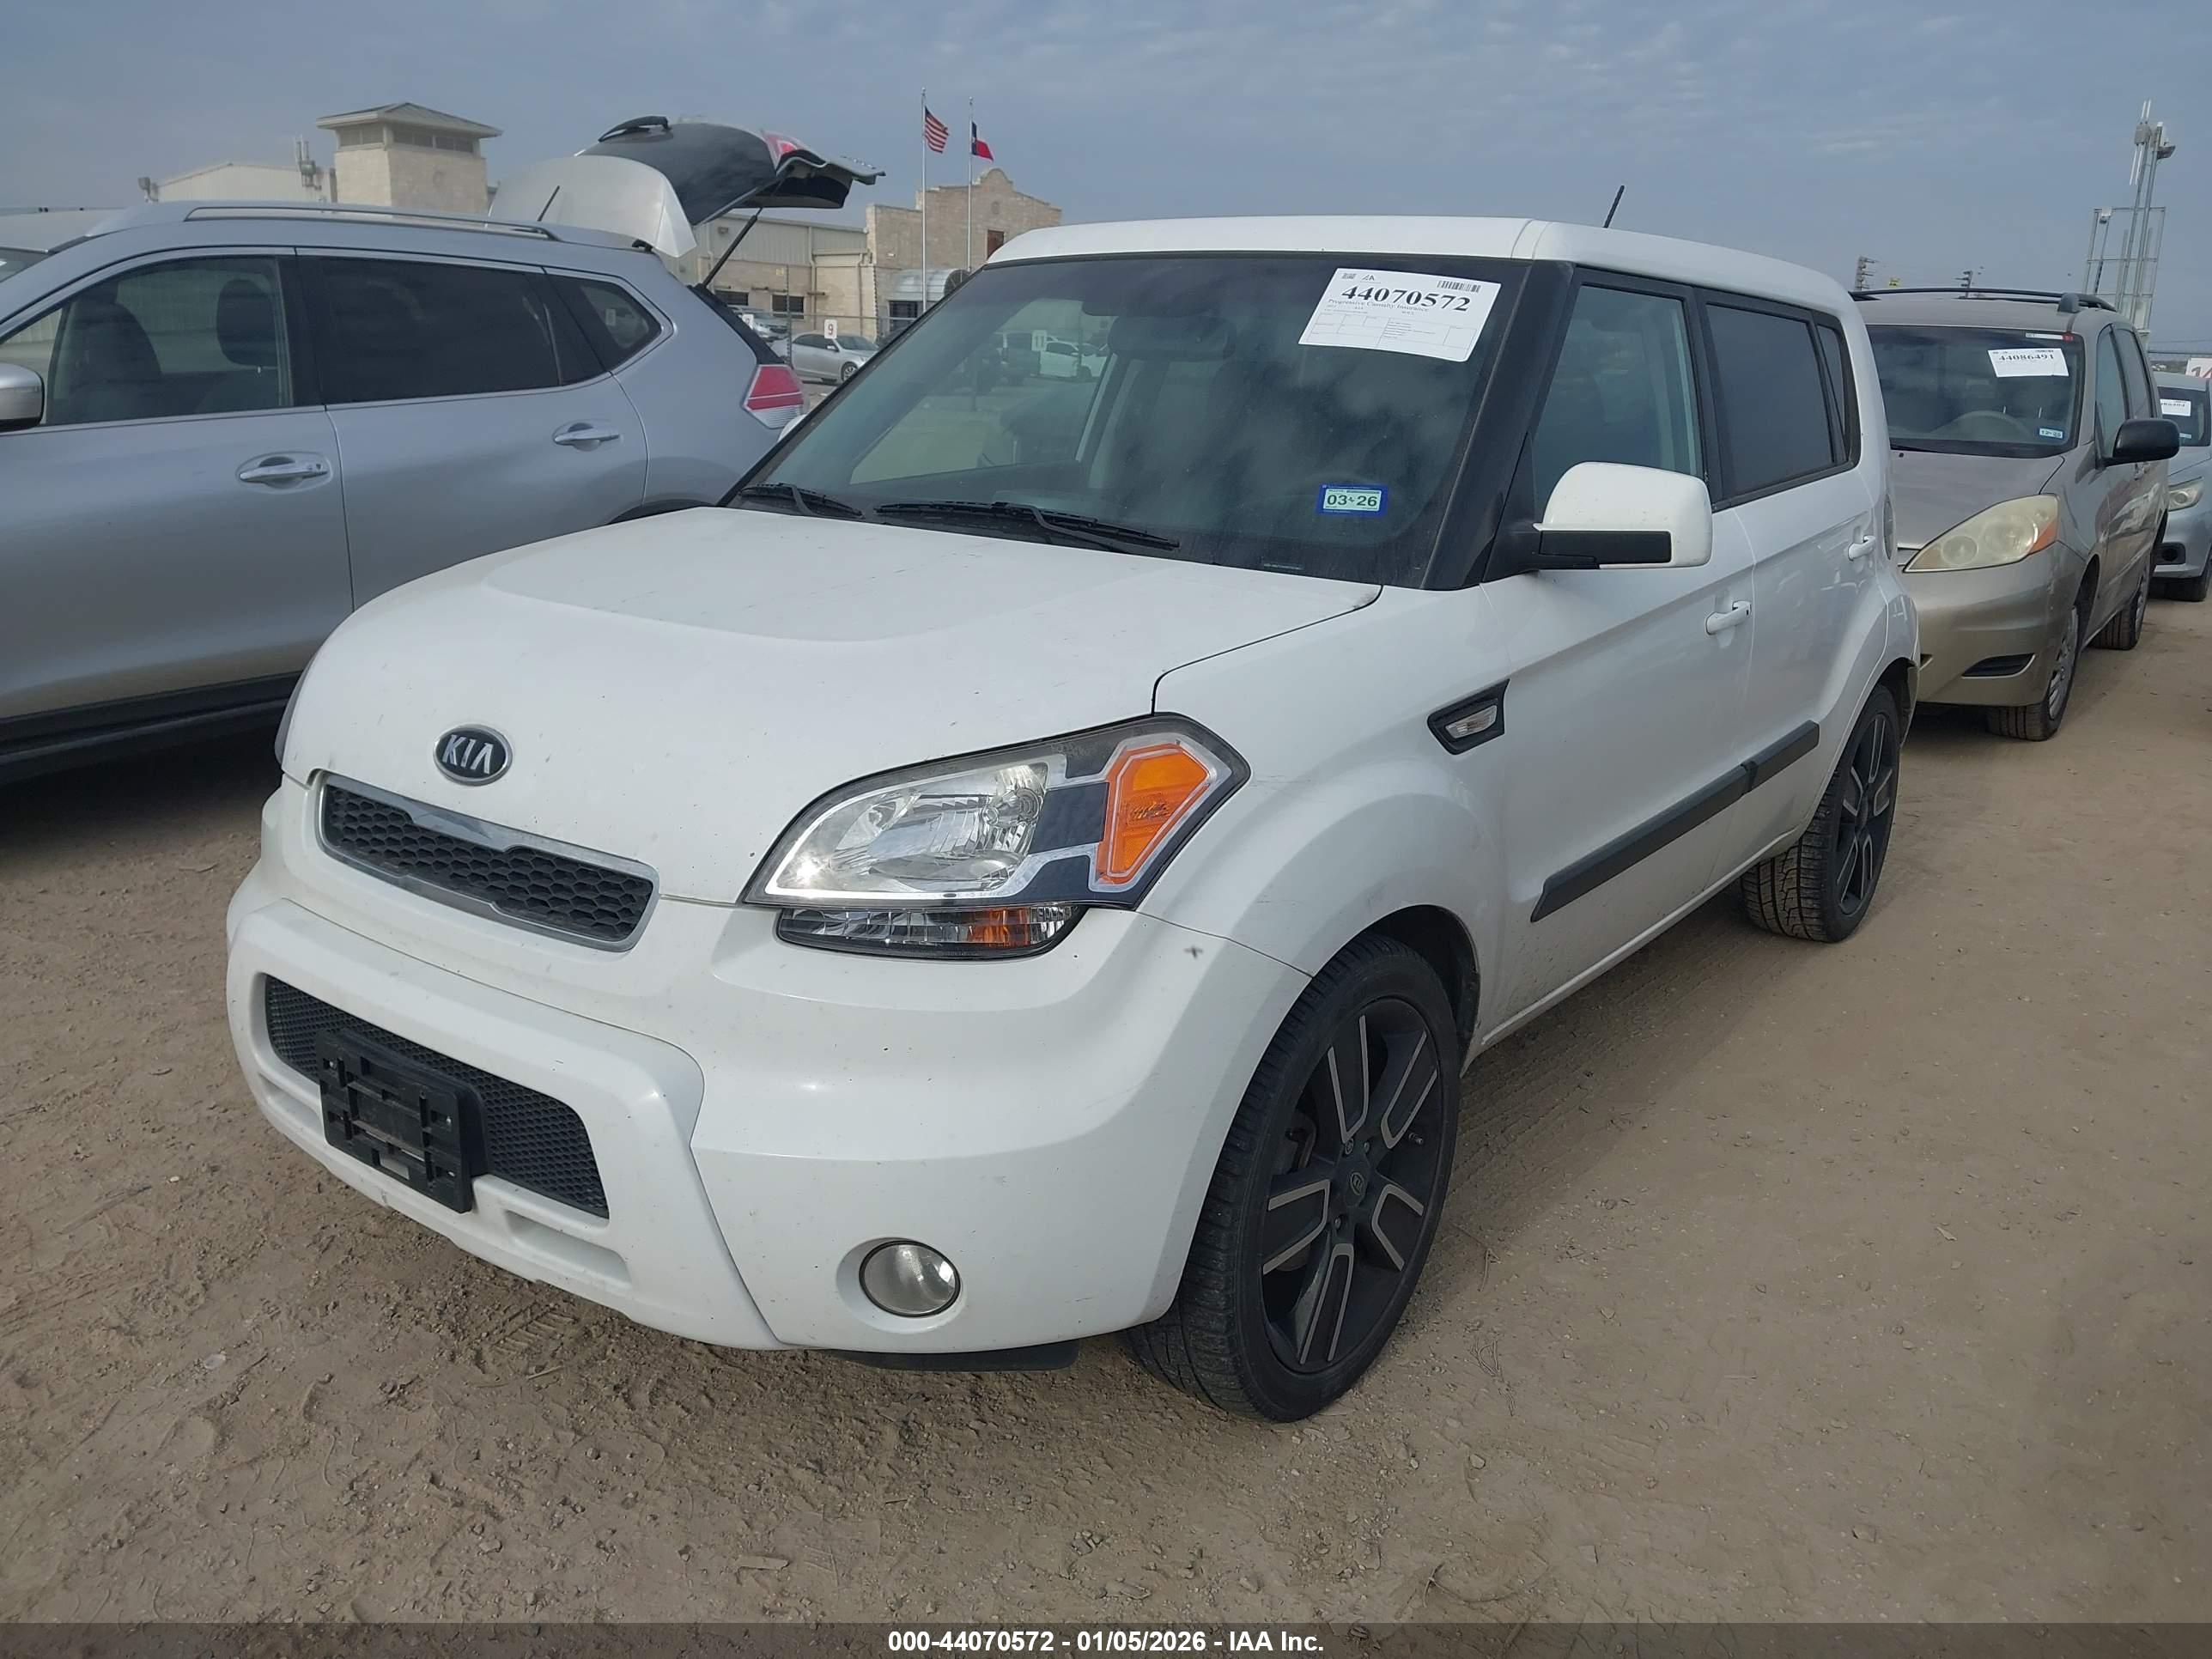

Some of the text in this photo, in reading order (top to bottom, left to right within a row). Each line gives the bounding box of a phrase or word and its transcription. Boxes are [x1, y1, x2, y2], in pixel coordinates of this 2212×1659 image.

[1341, 285, 1471, 312] 44070572
[827, 323, 834, 335] 9
[442, 734, 494, 775] KIA
